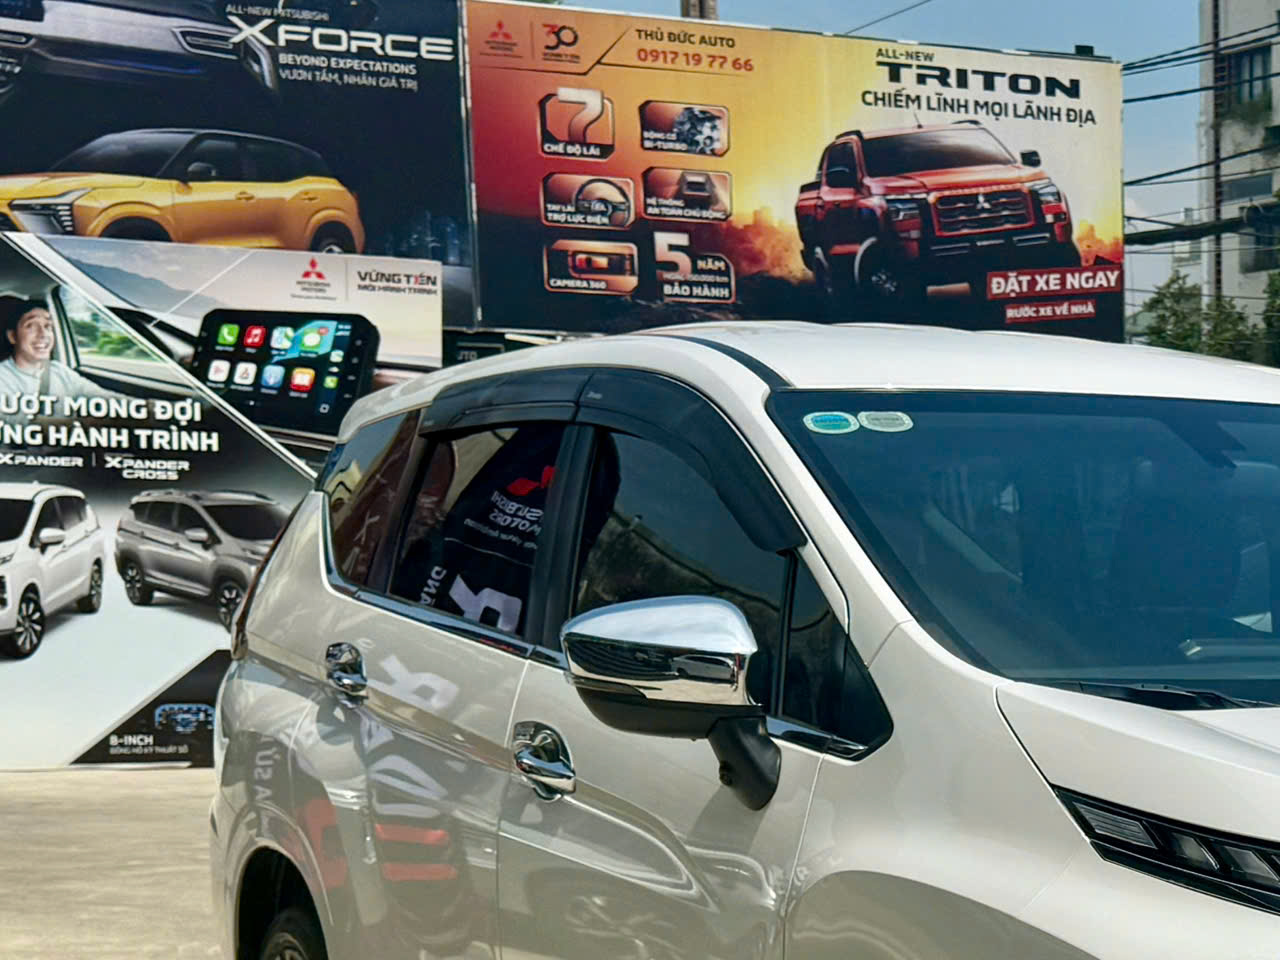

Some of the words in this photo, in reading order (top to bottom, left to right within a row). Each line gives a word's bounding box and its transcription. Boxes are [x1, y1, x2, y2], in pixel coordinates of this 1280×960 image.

[227, 15, 455, 61] XFORCE
[635, 28, 665, 43] THỦ
[668, 29, 696, 45] ĐỨC
[698, 35, 736, 49] AUTO
[278, 53, 329, 67] BEYOND
[330, 58, 417, 75] EXPECTATIONS
[637, 48, 679, 65] 0917
[684, 51, 703, 67] 19
[708, 54, 729, 69] 77
[731, 57, 755, 72] 66
[876, 48, 934, 62] ALL-NEW
[876, 60, 1081, 99] TRITON
[557, 87, 604, 143] 7
[861, 88, 921, 110] CHIẾM
[926, 93, 969, 114] LĨNH
[974, 100, 1008, 121] MỌI
[1013, 101, 1061, 122] LÃNH
[1066, 108, 1097, 128] ĐỊA
[653, 231, 692, 280] 5
[663, 282, 691, 296] BẢO
[692, 283, 730, 297] HÀNH
[991, 272, 1032, 298] ĐẶT
[1035, 273, 1061, 291] XE
[1066, 270, 1120, 290] NGAY
[64, 397, 148, 420] MONG
[154, 398, 201, 426] ĐỢI
[48, 421, 130, 449] HÀNH
[134, 425, 219, 452] TRÌNH
[104, 456, 191, 472] XPANDER
[122, 470, 179, 480] CROSS
